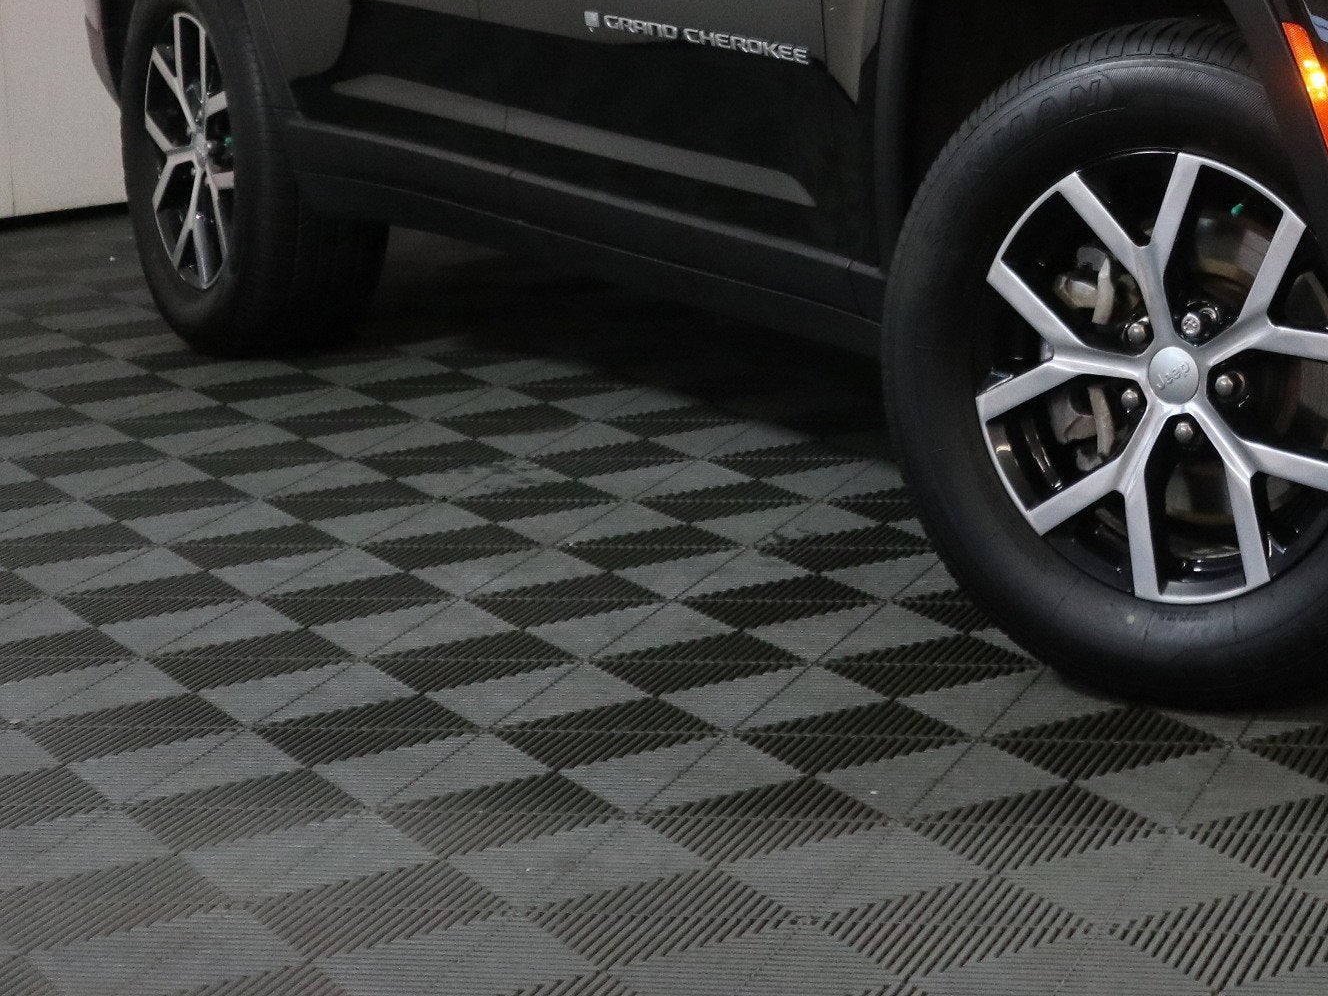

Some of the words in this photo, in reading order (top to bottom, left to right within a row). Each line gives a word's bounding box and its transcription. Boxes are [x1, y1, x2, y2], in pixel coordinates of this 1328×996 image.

[602, 13, 679, 40] GRAND
[682, 26, 811, 66] CHEROKEE
[1156, 360, 1191, 391] Jeep
